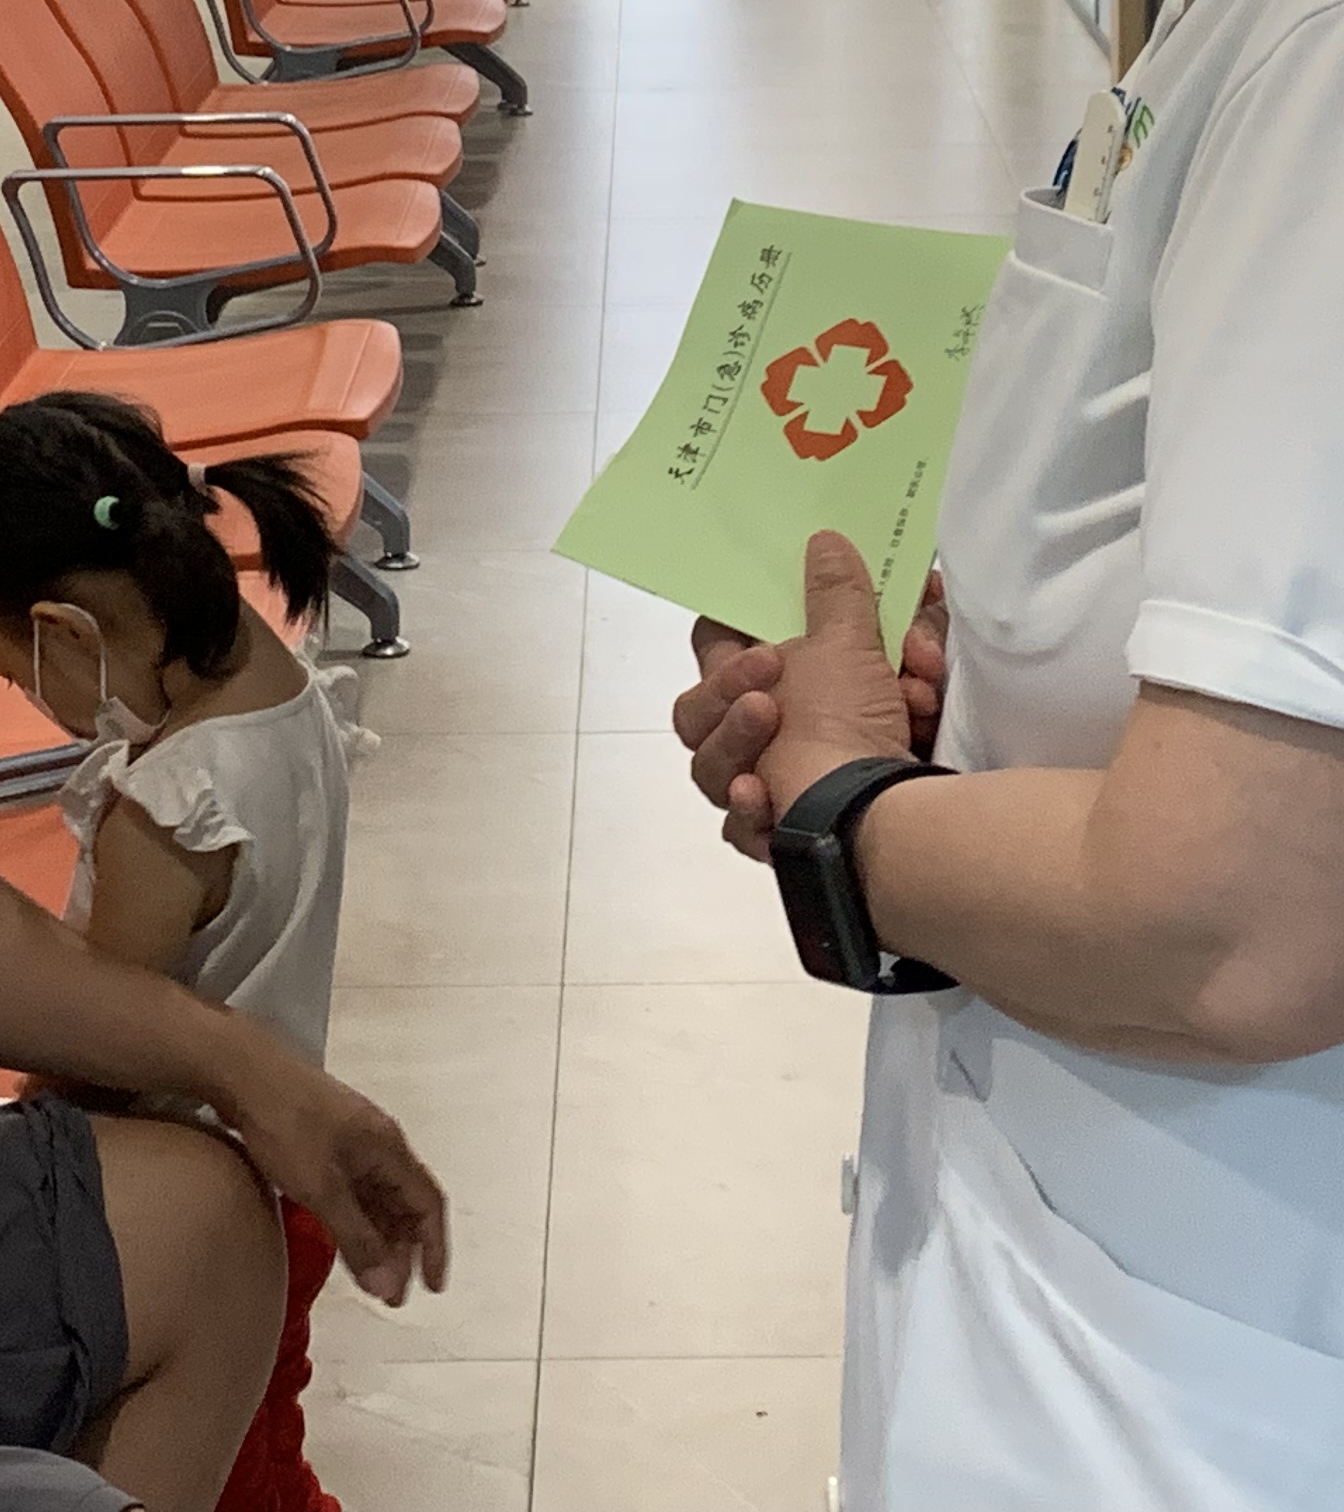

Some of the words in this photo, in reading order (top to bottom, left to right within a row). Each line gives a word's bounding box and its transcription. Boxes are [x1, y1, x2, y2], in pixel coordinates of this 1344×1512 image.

[667, 244, 783, 486] 天津市门(急)诊病历册
